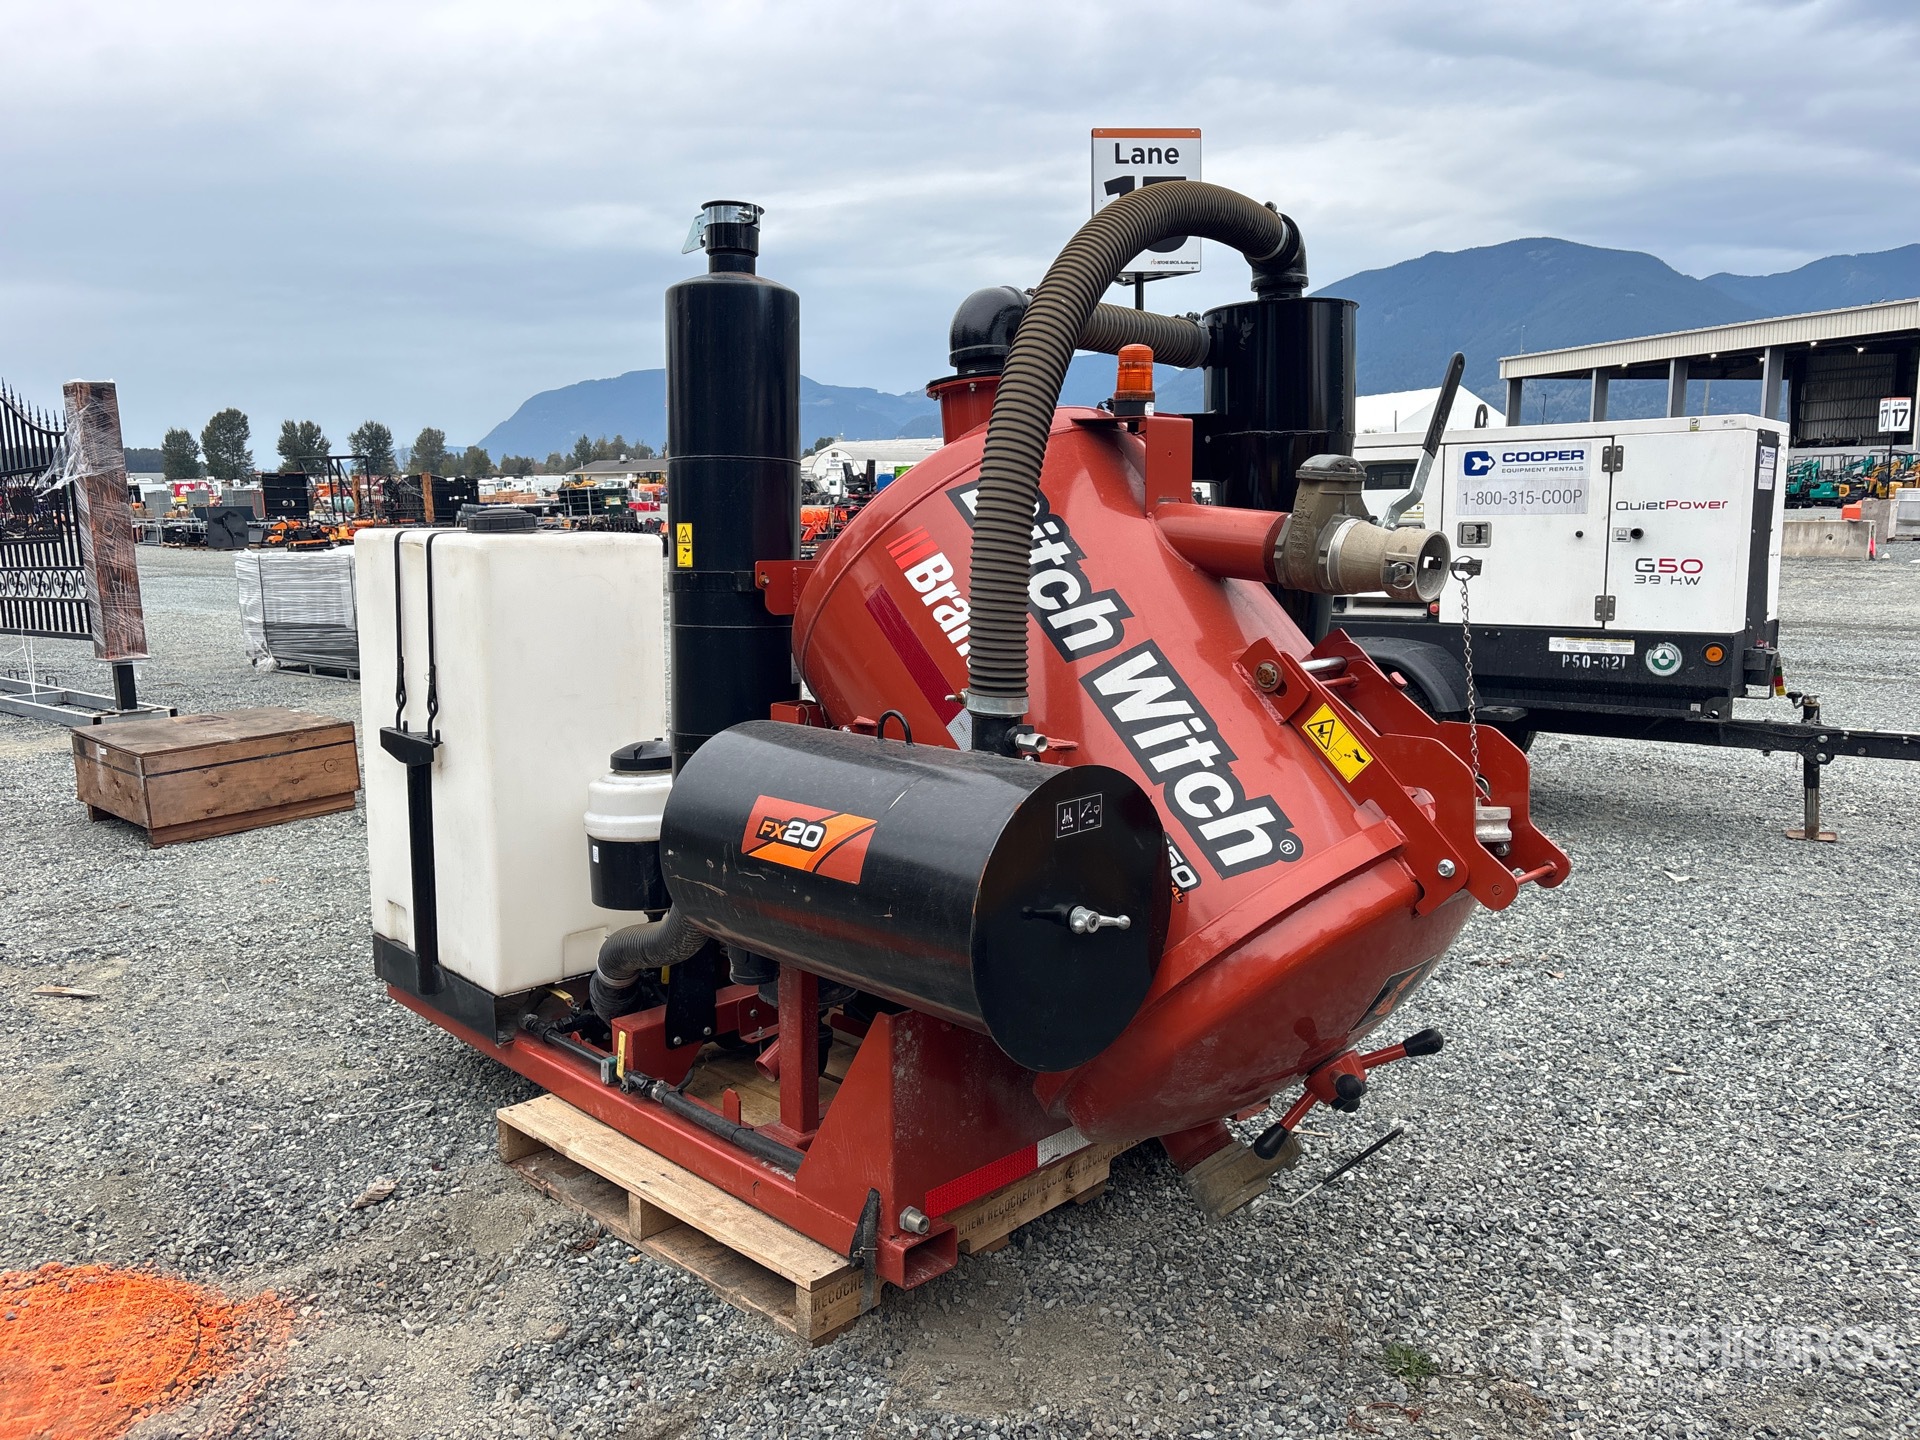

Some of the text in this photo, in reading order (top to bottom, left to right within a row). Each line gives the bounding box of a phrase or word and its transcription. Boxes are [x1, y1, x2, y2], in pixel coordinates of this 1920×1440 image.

[1114, 142, 1180, 165] Lane
[1880, 409, 1888, 427] 17
[1892, 408, 1908, 426] 17
[1502, 449, 1585, 463] COOPER
[1502, 465, 1584, 474] EQUIPMENT RENTALS
[1463, 489, 1583, 506] 1-800-315-COOP
[1615, 499, 1729, 511] QuietPower
[959, 487, 1119, 652] itch
[1635, 557, 1704, 574] G50
[1634, 574, 1661, 585] 38
[1562, 653, 1626, 670] P50-821
[759, 820, 824, 848] FX20
[1166, 837, 1198, 889] 50
[987, 1187, 1037, 1222] RECOCHEM
[813, 1276, 864, 1313] RECOCHE
